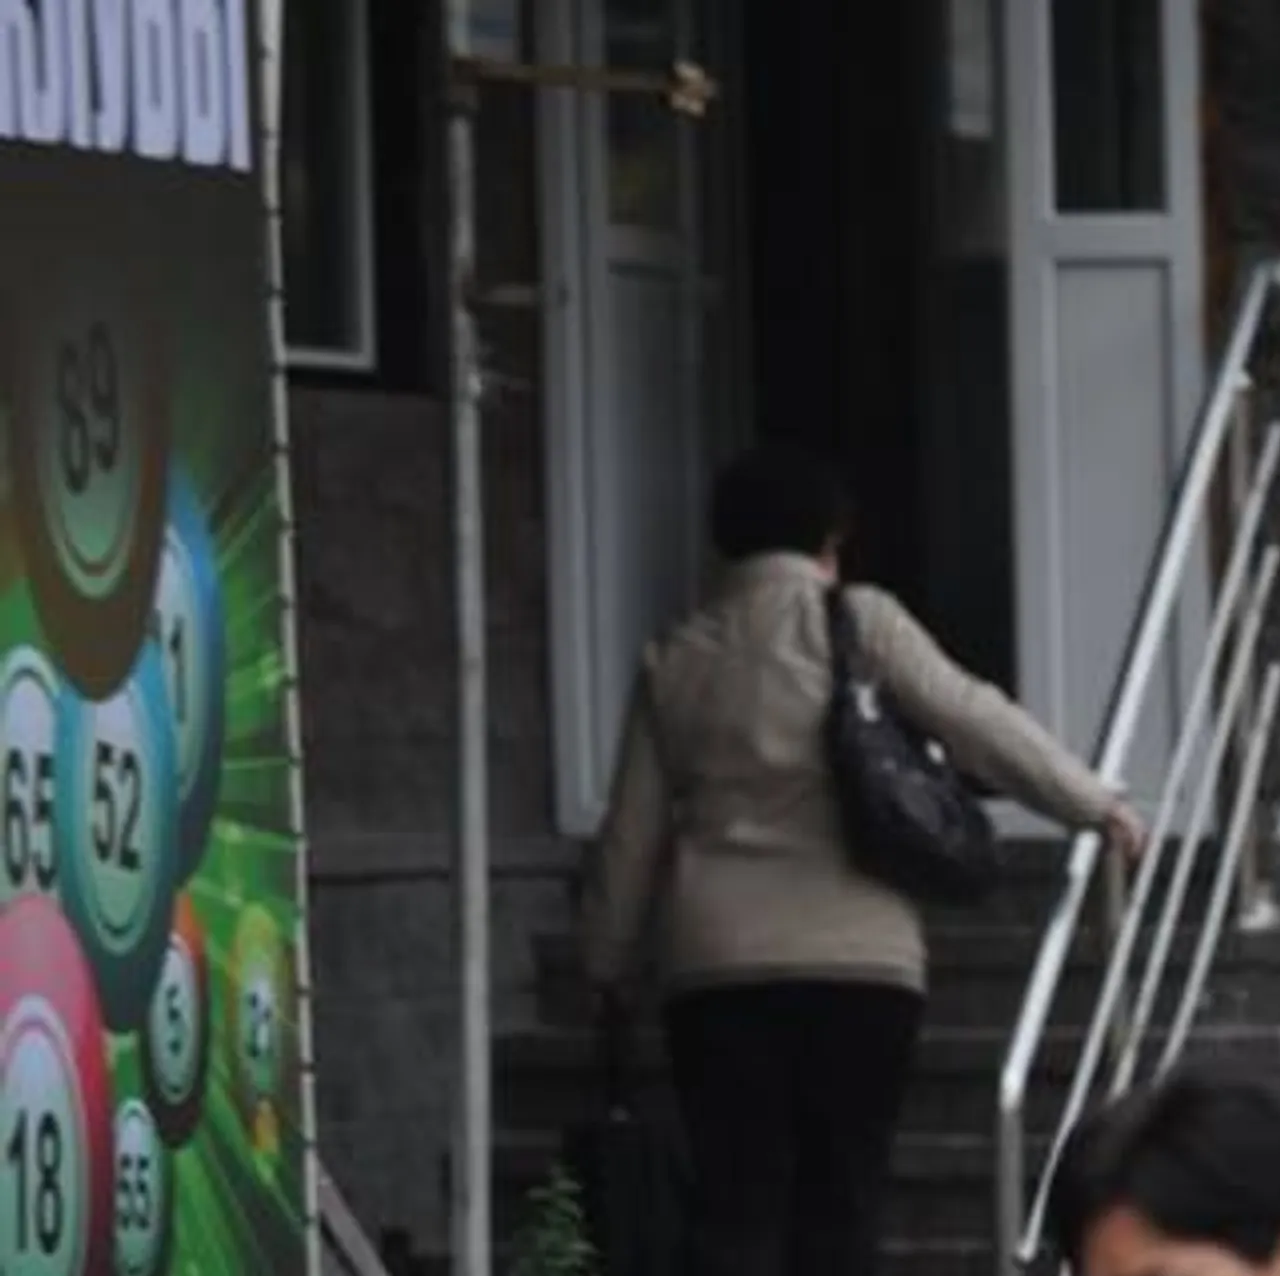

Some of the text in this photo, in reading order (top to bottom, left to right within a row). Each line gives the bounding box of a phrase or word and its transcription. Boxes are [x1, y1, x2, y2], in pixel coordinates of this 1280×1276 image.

[58, 322, 121, 494] 89
[3, 748, 58, 890] 65
[93, 740, 142, 871] 52
[8, 1108, 63, 1256] 18
